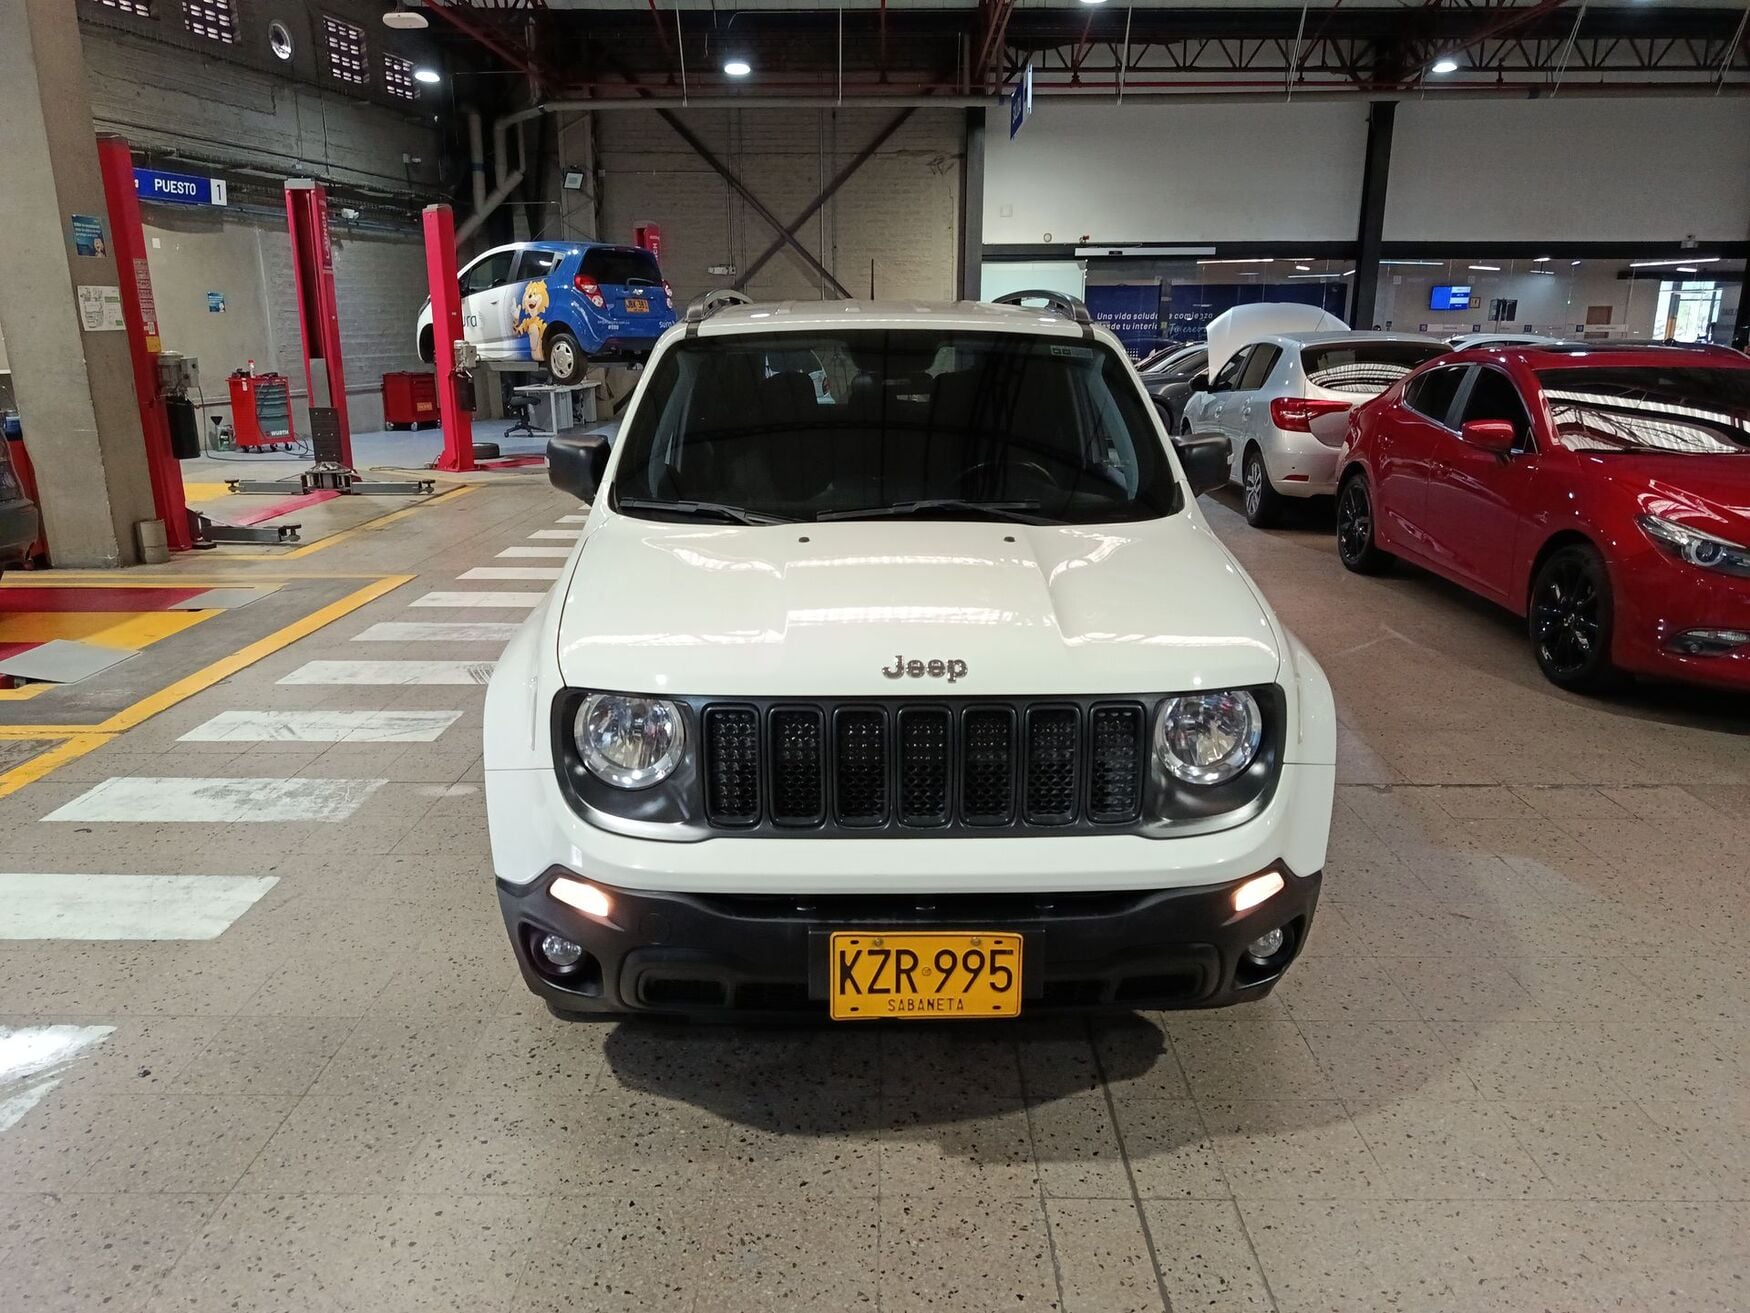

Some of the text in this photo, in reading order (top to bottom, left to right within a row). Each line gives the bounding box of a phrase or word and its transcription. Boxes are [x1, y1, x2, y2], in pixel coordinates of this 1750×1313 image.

[154, 178, 196, 196] PUESTO
[216, 184, 222, 201] 1
[1096, 312, 1113, 320] Una
[1114, 311, 1132, 320] vida
[882, 655, 968, 684] Jeep
[839, 949, 1014, 995] KZR 995
[887, 998, 964, 1012] SABANETA
